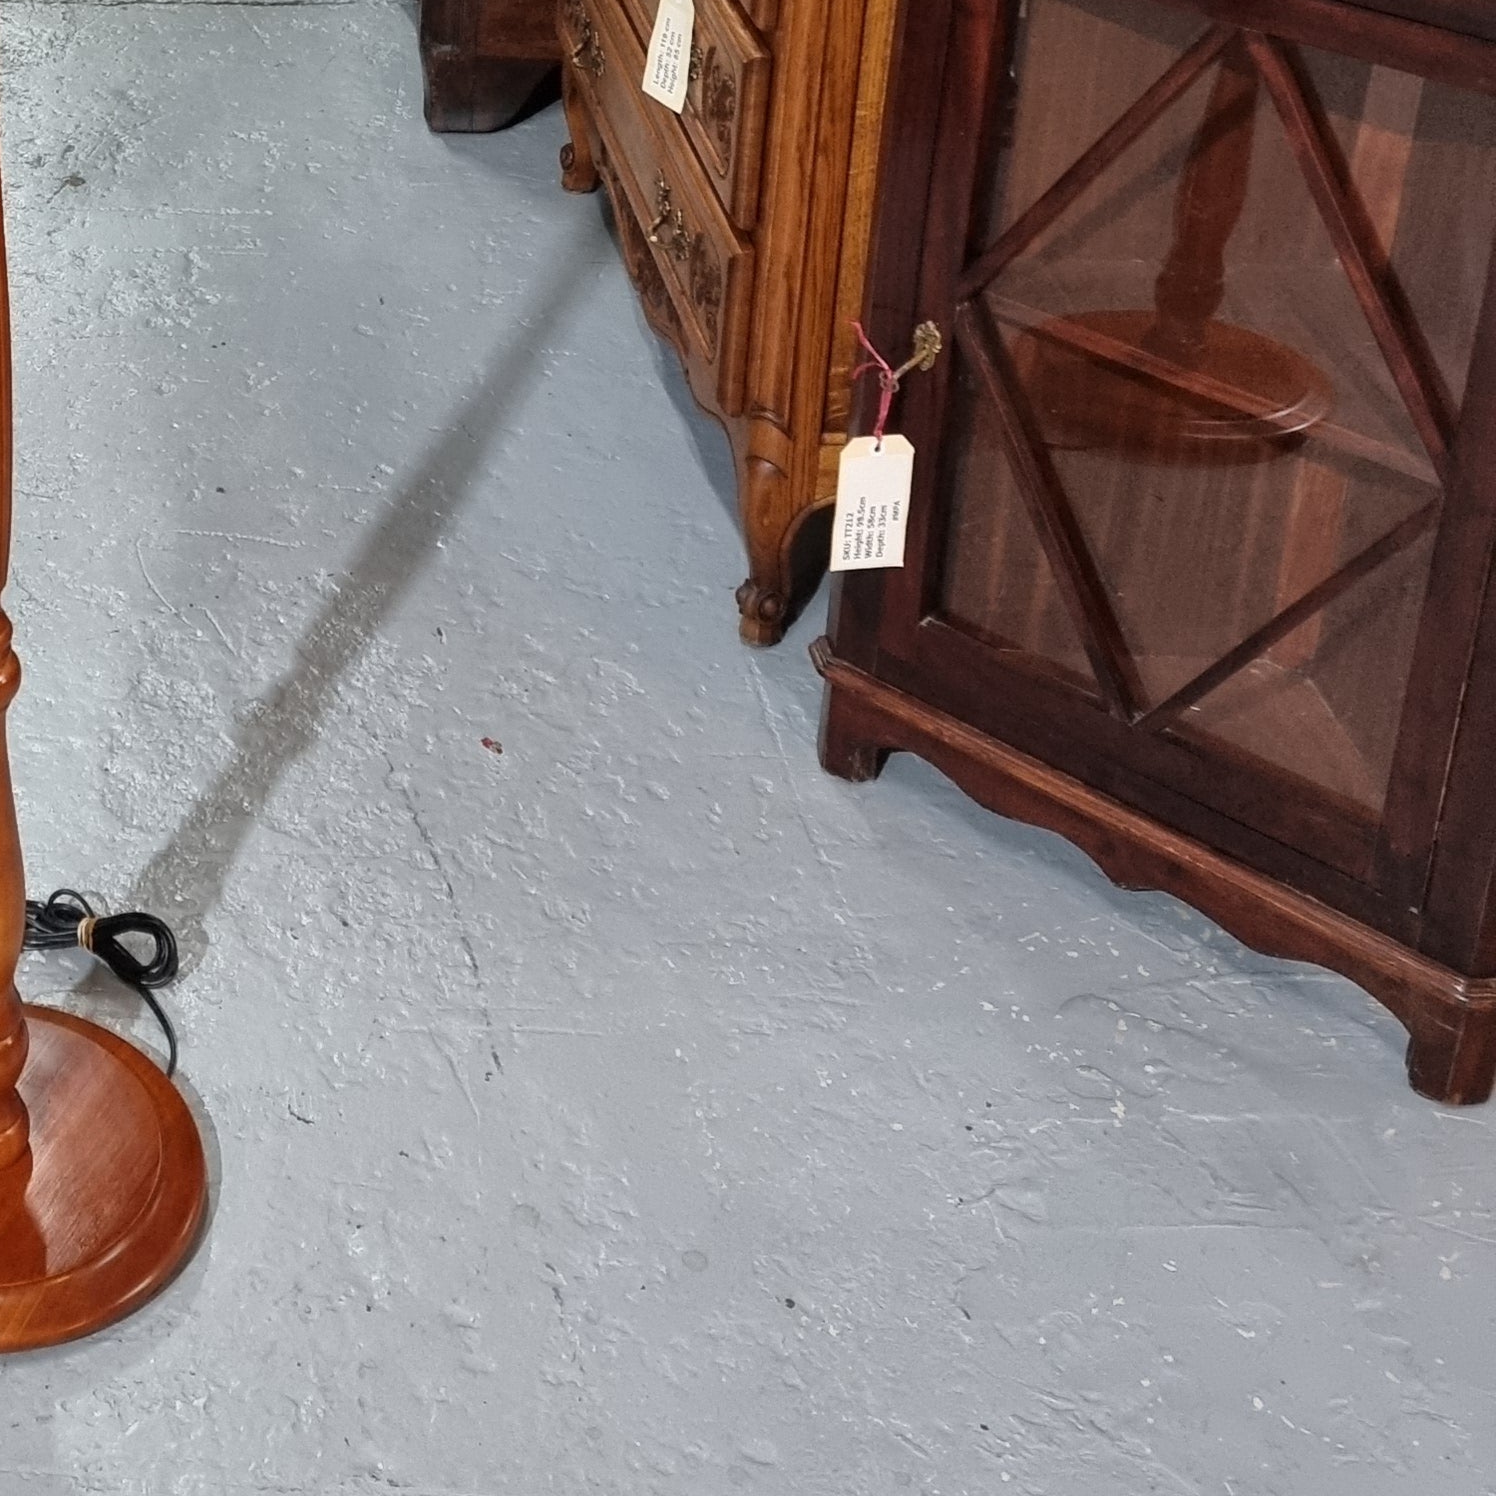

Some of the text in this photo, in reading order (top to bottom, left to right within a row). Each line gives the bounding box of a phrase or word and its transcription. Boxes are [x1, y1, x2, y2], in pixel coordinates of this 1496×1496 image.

[665, 17, 671, 32] cm
[670, 31, 675, 46] cm
[677, 33, 682, 47] cm
[842, 539, 852, 560] SKU:
[853, 529, 864, 560] Height:
[864, 530, 875, 559] Width:
[875, 529, 886, 558] Depth:
